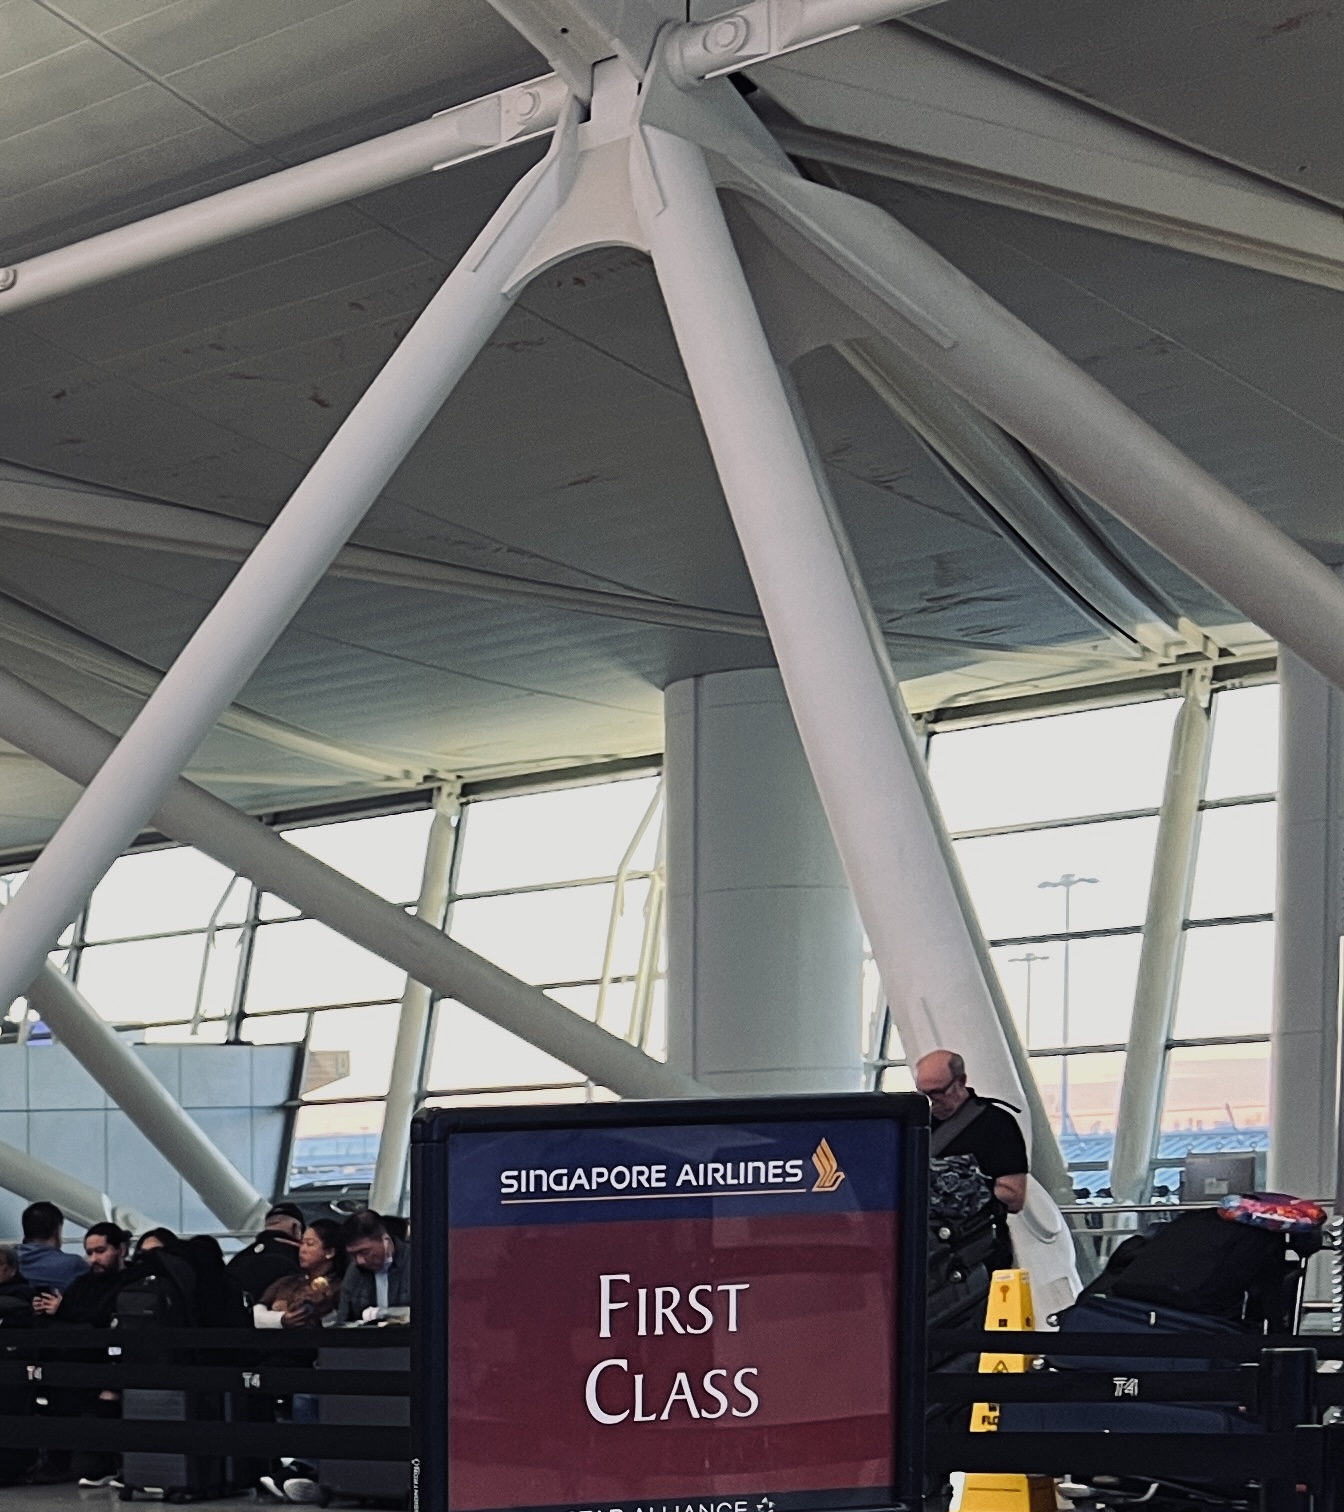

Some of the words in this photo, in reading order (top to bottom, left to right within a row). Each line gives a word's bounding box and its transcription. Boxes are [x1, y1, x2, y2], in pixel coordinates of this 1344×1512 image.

[500, 1165, 668, 1195] SINGAPORE
[675, 1159, 804, 1187] AIRLINES
[598, 1273, 750, 1338] FIRST
[586, 1358, 759, 1425] CLASS
[1112, 1376, 1139, 1397] T4
